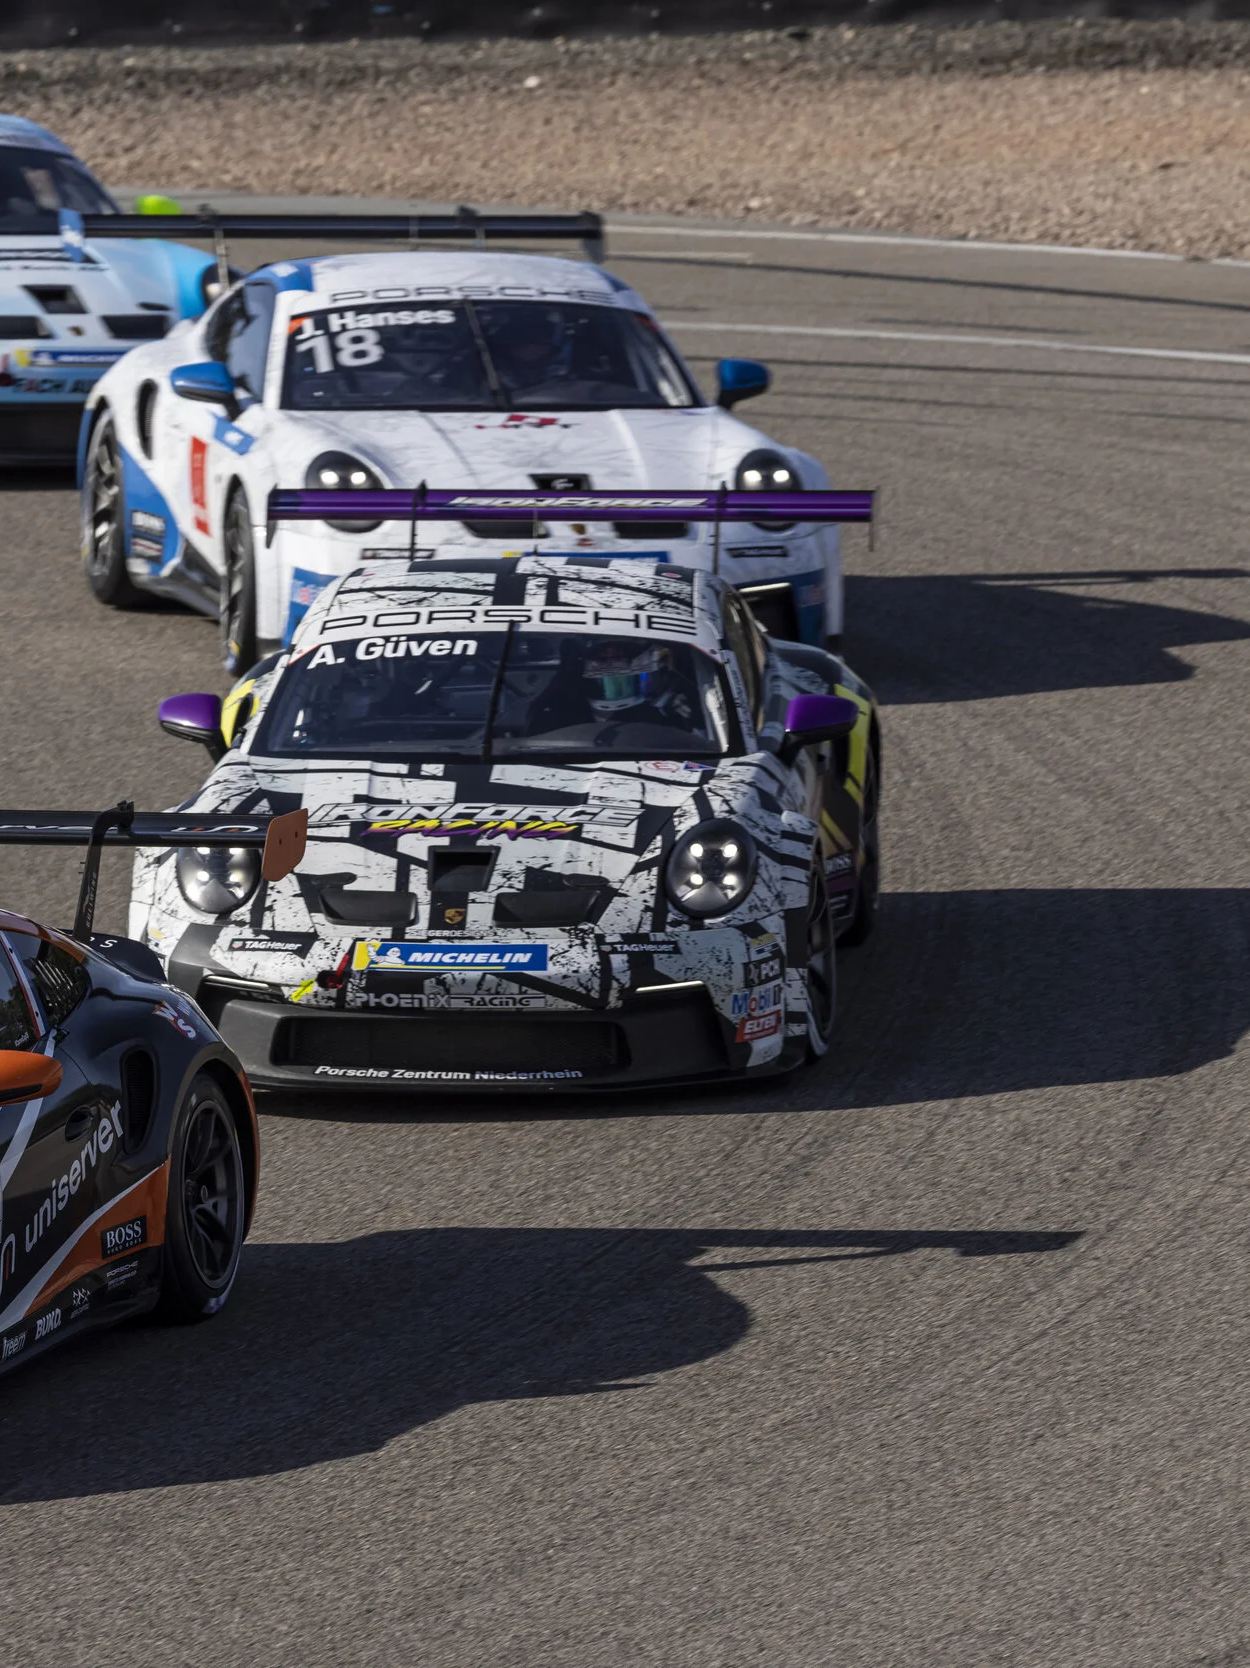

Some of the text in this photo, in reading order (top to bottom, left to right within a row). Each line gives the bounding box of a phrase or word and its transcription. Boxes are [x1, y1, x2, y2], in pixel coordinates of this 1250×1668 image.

[330, 286, 616, 302] PORSCHE
[295, 308, 456, 340] J. Hanses
[295, 328, 385, 374] 18
[320, 609, 698, 636] PORSCHE
[306, 636, 479, 670] A. Güven
[308, 802, 646, 827] IRONFORCE
[360, 818, 579, 840] RACING
[244, 940, 303, 951] TAGHeuer
[408, 952, 533, 964] MICHELIN
[731, 987, 772, 1014] Mobil
[314, 1065, 583, 1080] Porsche Zentrum Niederrhein
[25, 1099, 124, 1253] uniserver
[106, 1220, 142, 1249] BOSS
